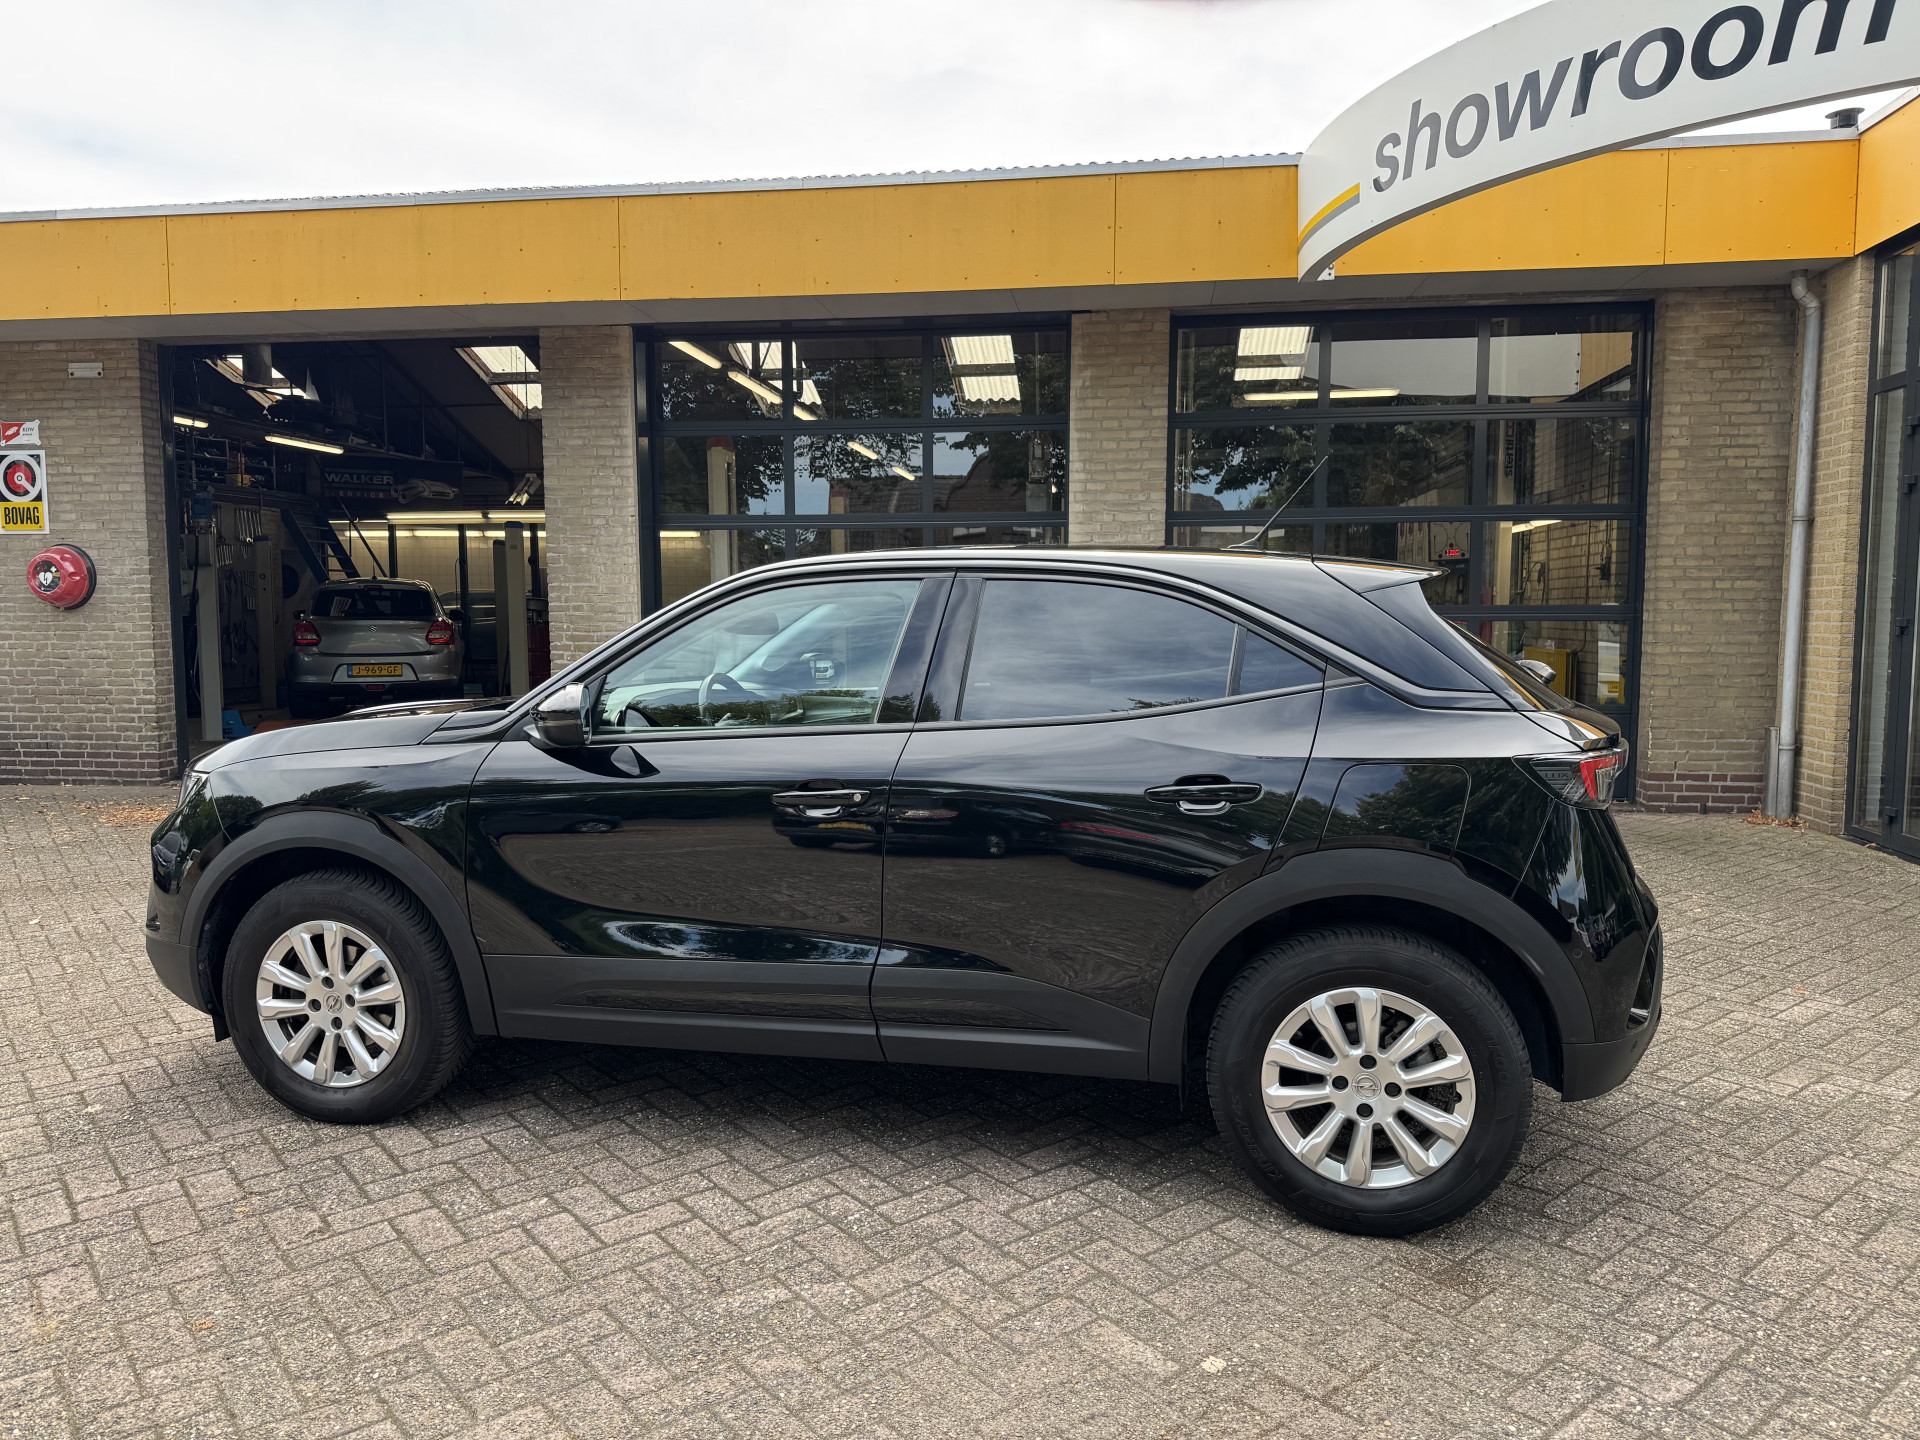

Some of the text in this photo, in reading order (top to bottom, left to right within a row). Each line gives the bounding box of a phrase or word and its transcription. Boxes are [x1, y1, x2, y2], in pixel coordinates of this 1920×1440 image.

[1372, 0, 1897, 193] showroom
[325, 472, 395, 485] WALKER
[4, 506, 40, 525] BOVAG
[355, 665, 399, 675] J-969-GF
